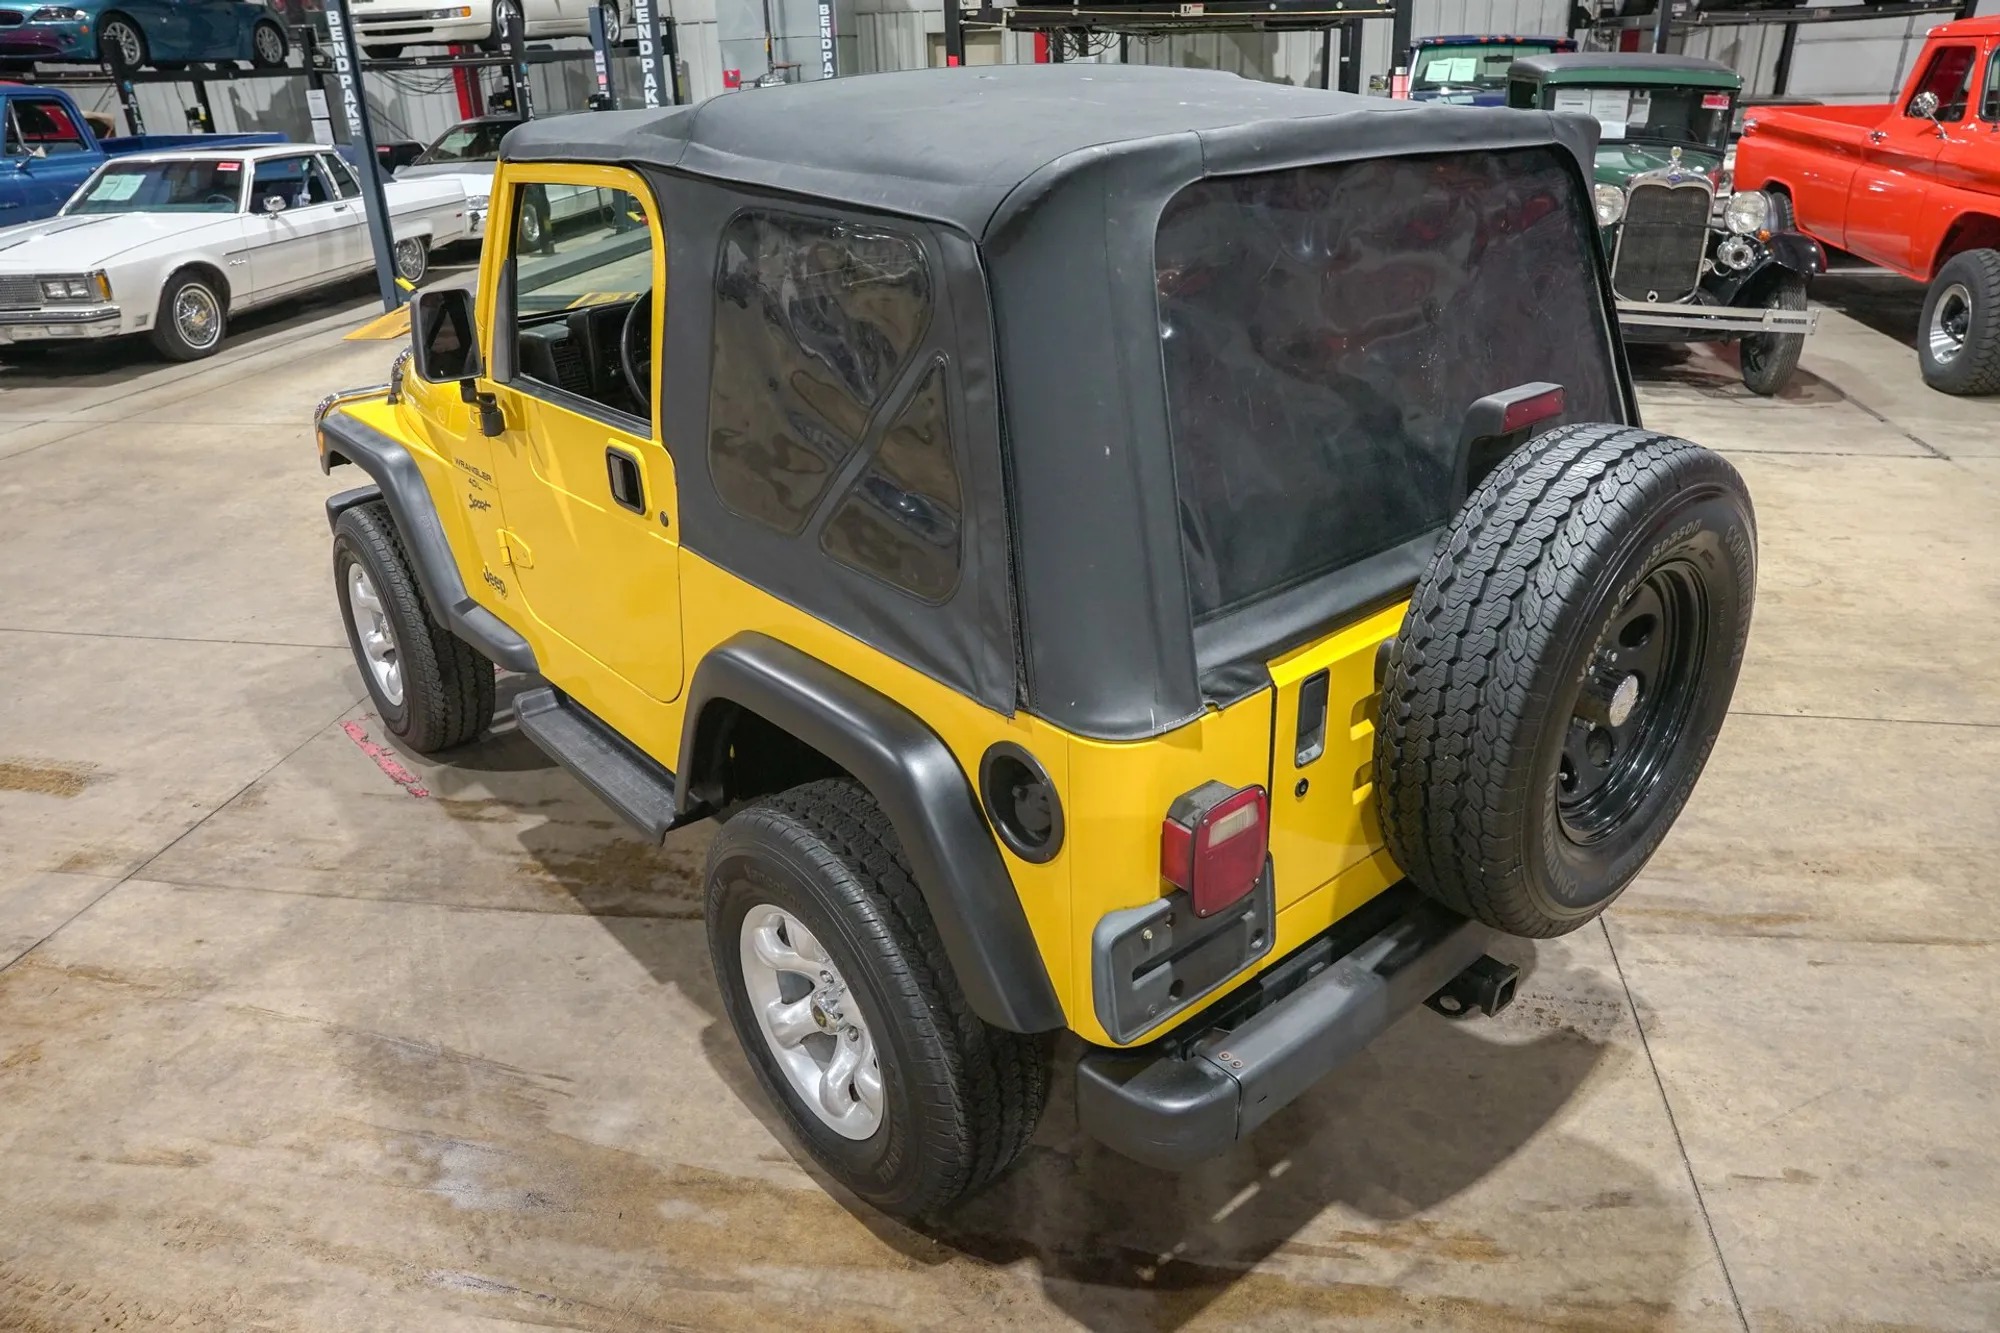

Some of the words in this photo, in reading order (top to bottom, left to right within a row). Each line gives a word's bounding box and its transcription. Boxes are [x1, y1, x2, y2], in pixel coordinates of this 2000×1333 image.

[326, 10, 359, 118] BENDPAK
[523, 75, 535, 120] ATLA
[455, 457, 492, 483] WRANGLER
[468, 493, 491, 513] Sport
[483, 565, 508, 599] Jeep
